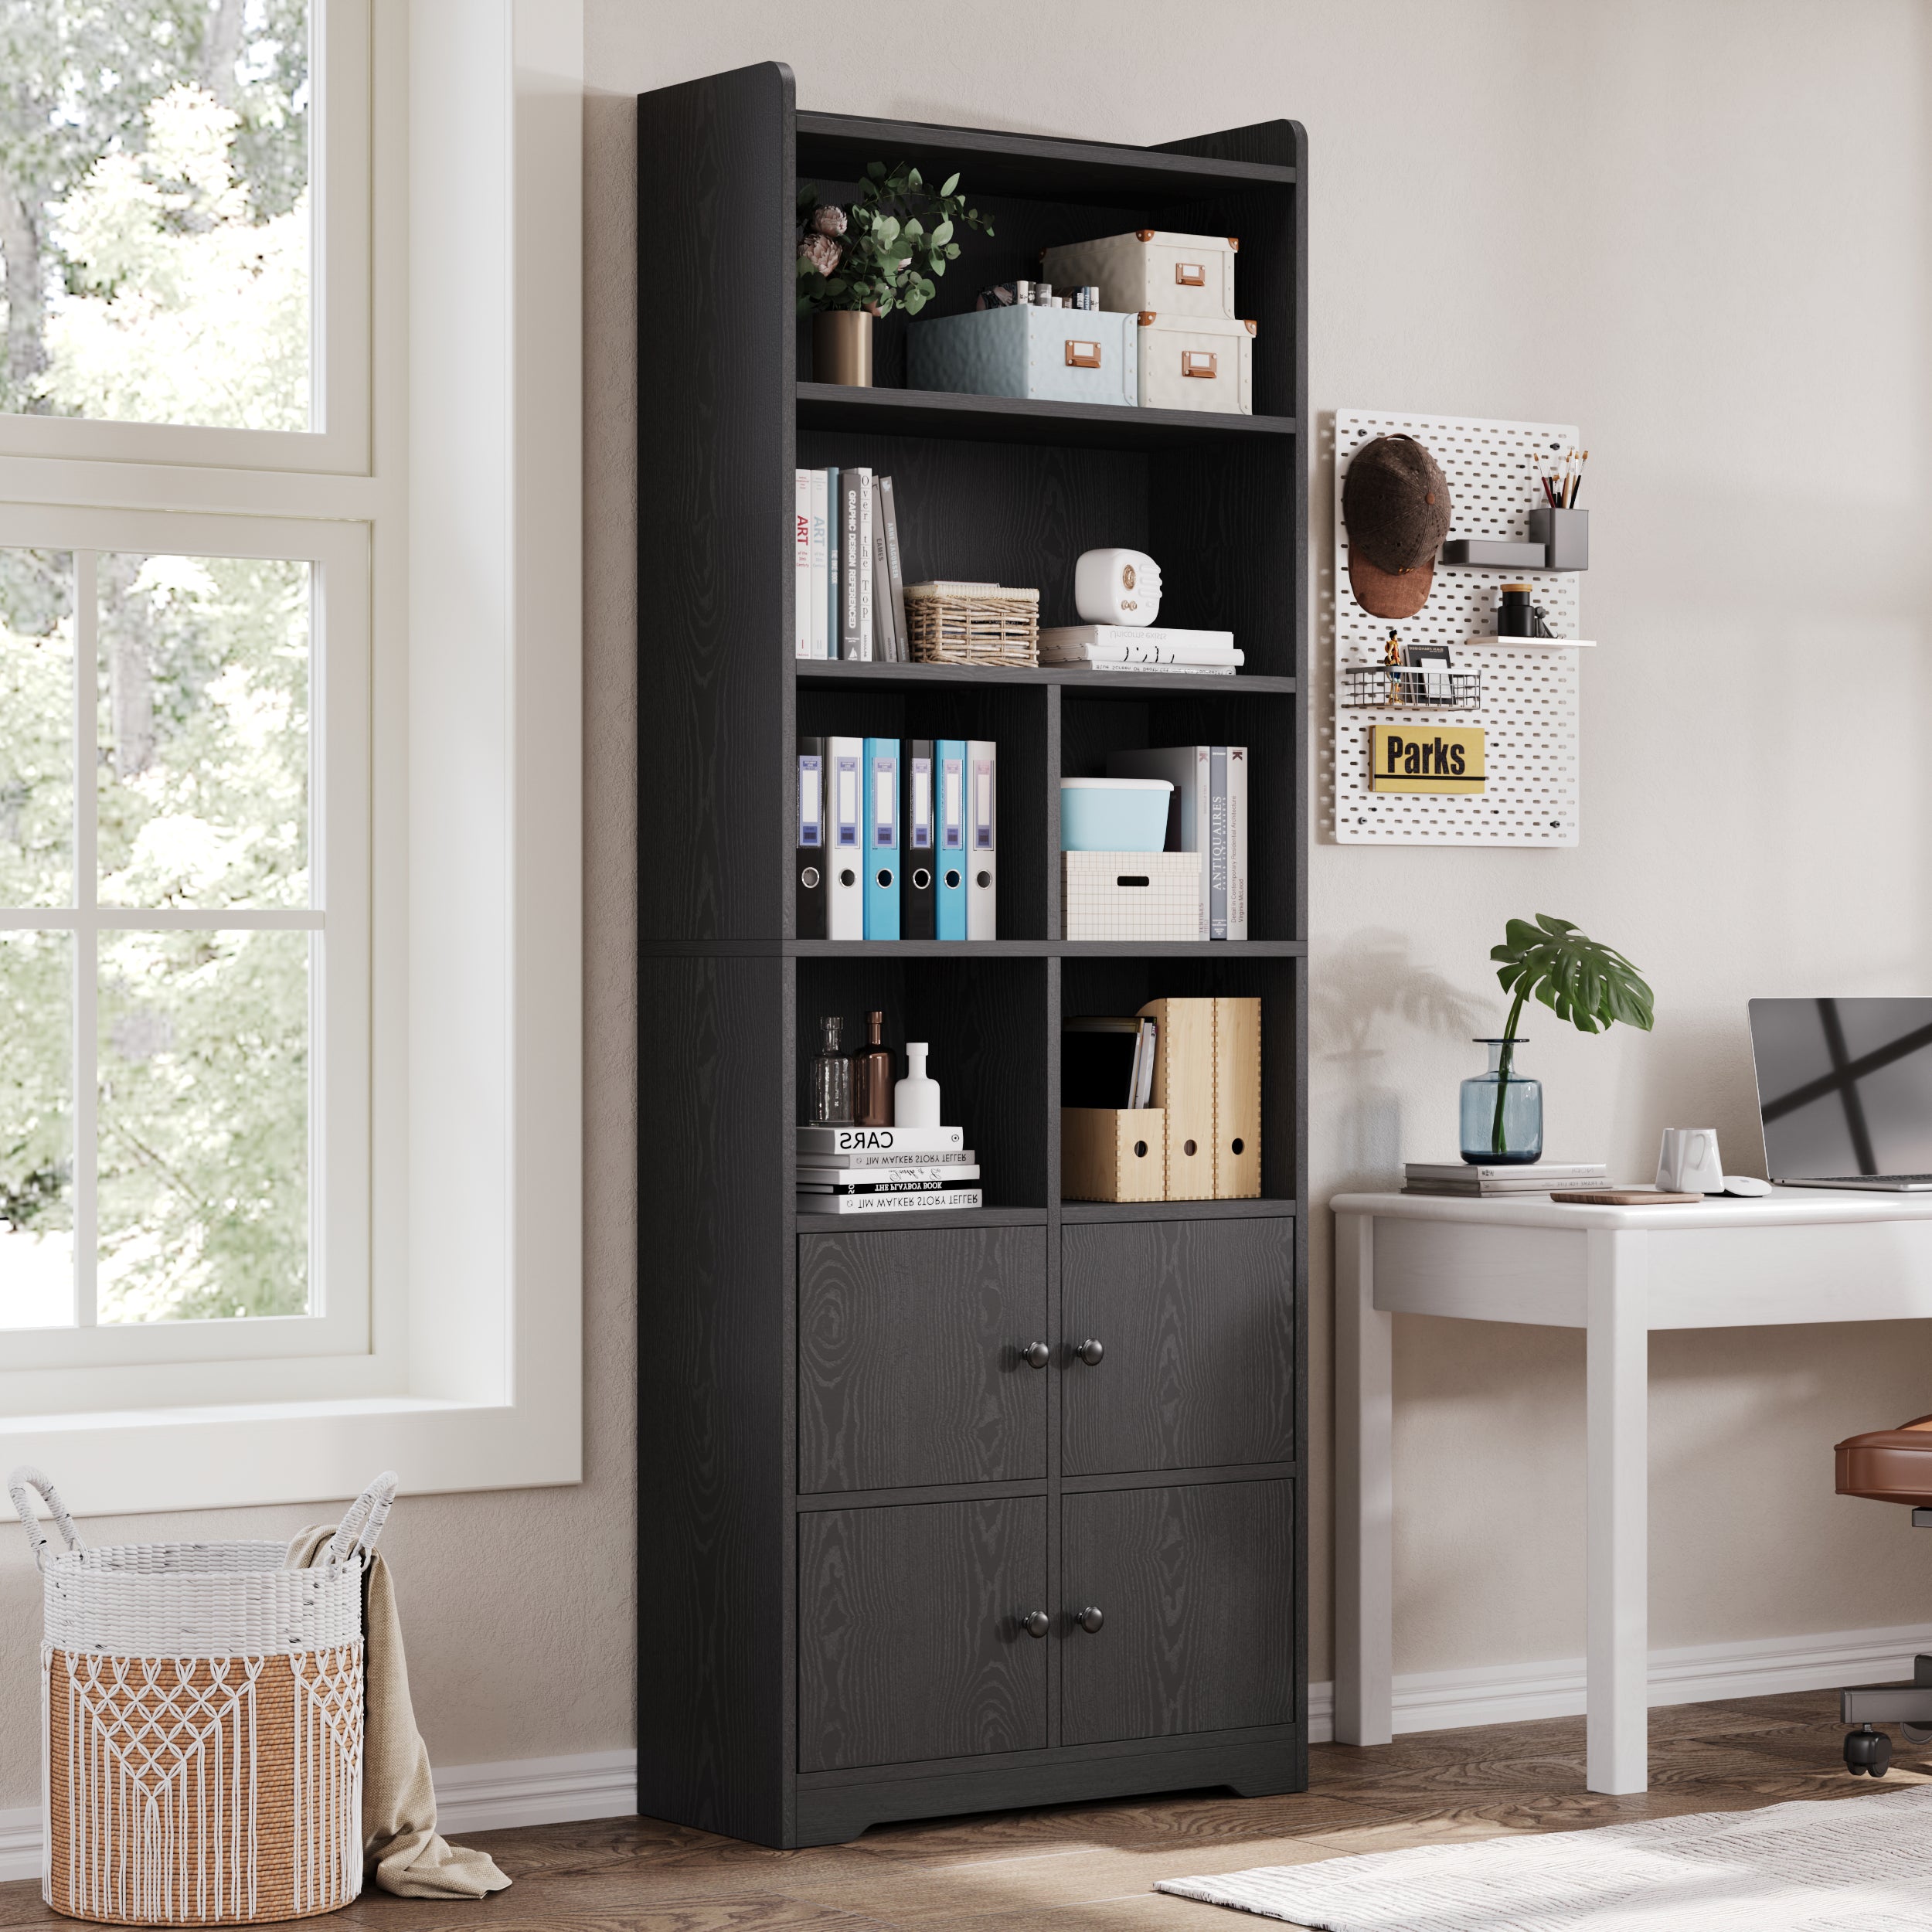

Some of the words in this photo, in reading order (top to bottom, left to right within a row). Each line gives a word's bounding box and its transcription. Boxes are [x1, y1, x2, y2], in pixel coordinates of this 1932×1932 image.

[798, 515, 808, 546] ART
[814, 516, 825, 546] ART
[889, 543, 898, 578] JACOBSEN
[1387, 736, 1465, 775] Parks
[1212, 797, 1223, 890] ANTIQUAIRES
